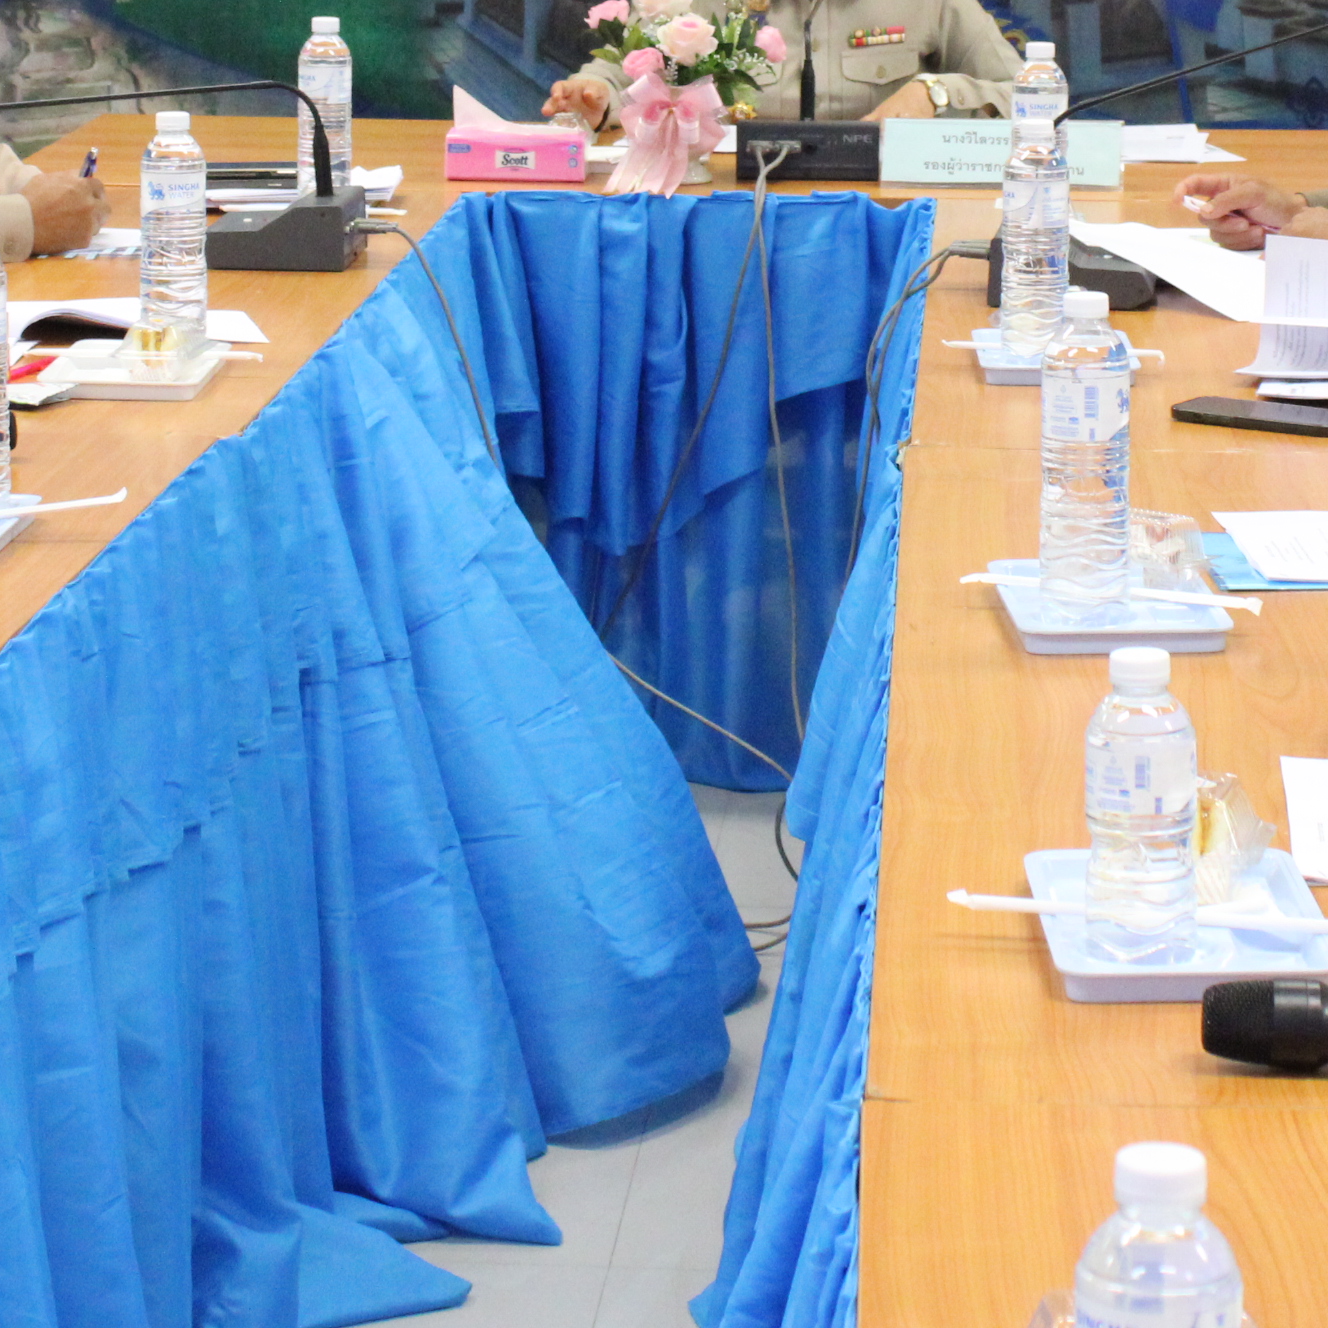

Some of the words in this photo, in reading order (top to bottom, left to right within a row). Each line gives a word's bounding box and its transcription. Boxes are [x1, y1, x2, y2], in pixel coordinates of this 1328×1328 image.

[942, 131, 1010, 147] นางวิไลวรร
[501, 153, 529, 166] Scott
[168, 182, 200, 192] SINGHA
